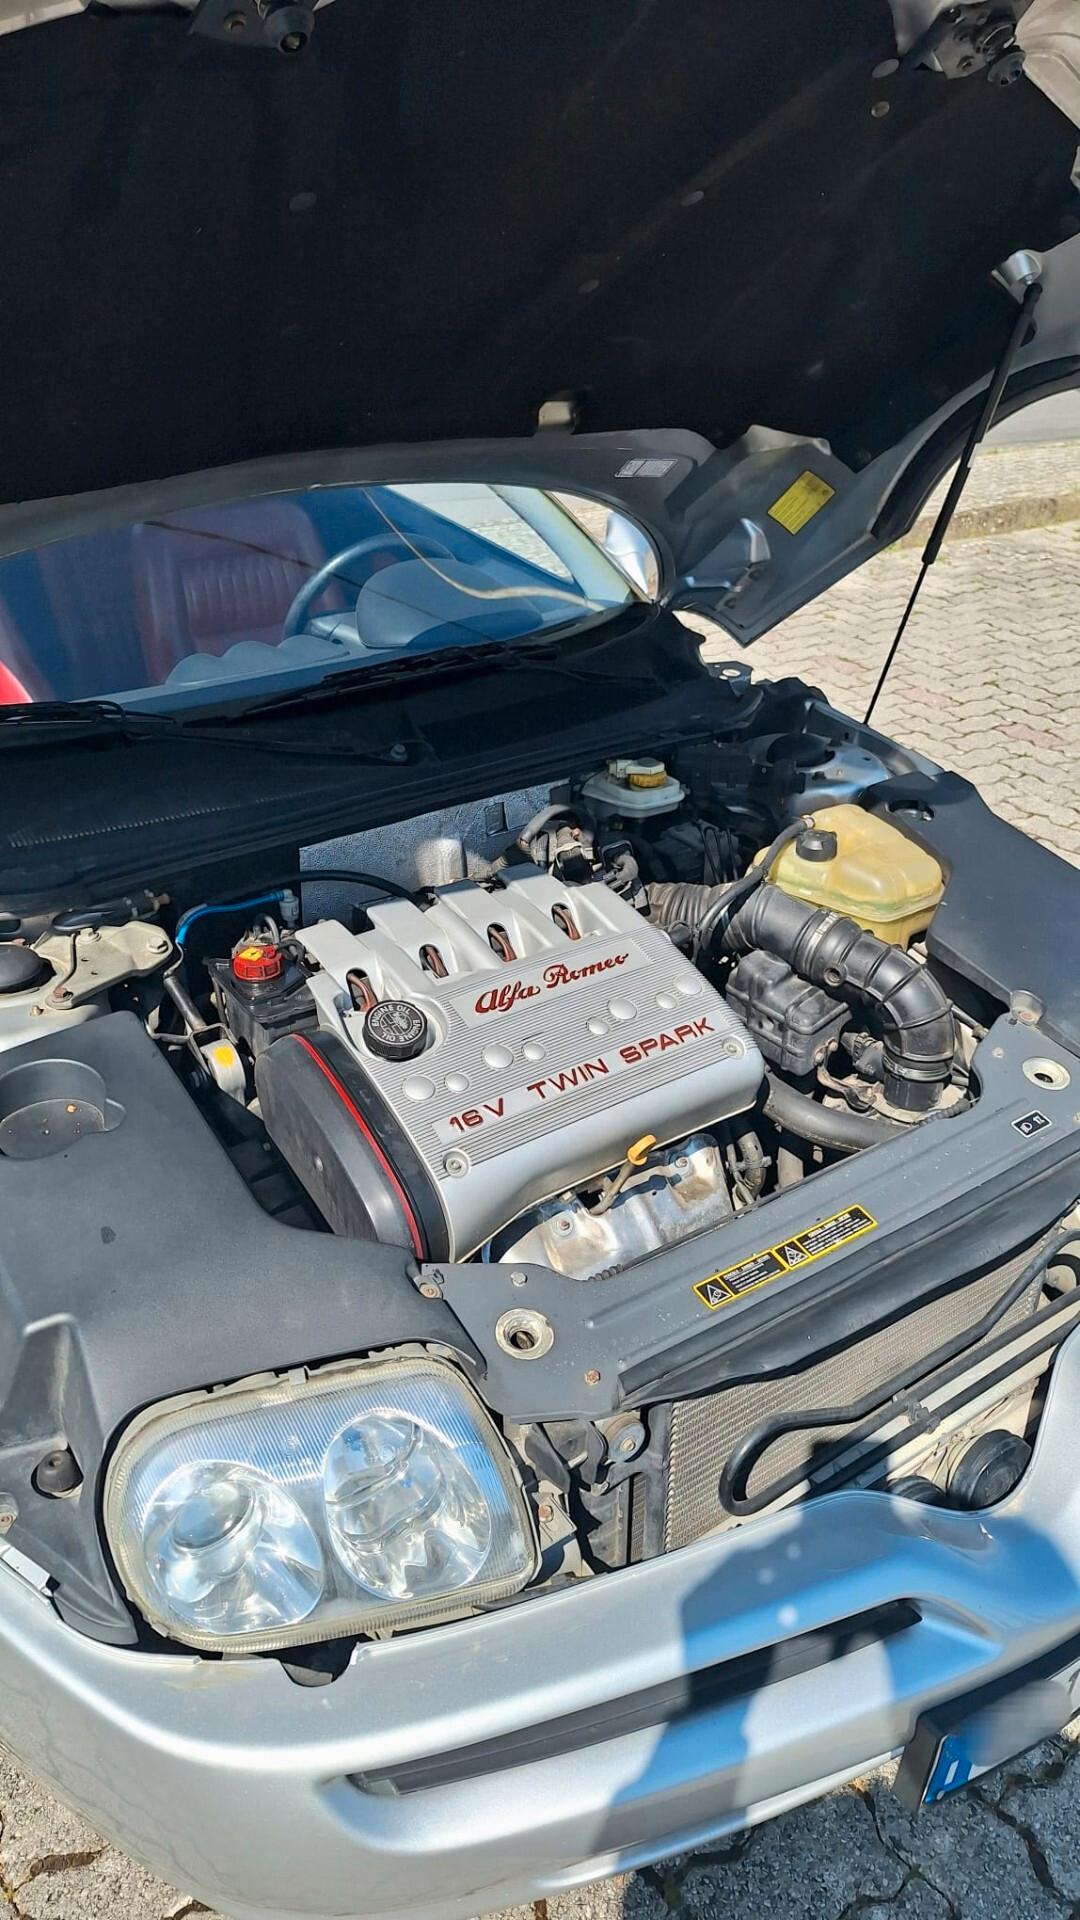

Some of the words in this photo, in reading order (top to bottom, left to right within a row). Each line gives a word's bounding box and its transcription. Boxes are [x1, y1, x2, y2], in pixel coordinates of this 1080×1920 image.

[474, 980, 541, 1014] Alfa
[543, 953, 629, 989] Romeo
[371, 1004, 394, 1027] ENGINE
[396, 1004, 410, 1015] OIL
[381, 1032, 396, 1042] OIL
[399, 1019, 422, 1042] ENGINE
[526, 1058, 610, 1100] TWIN
[619, 1017, 715, 1065] SPARK
